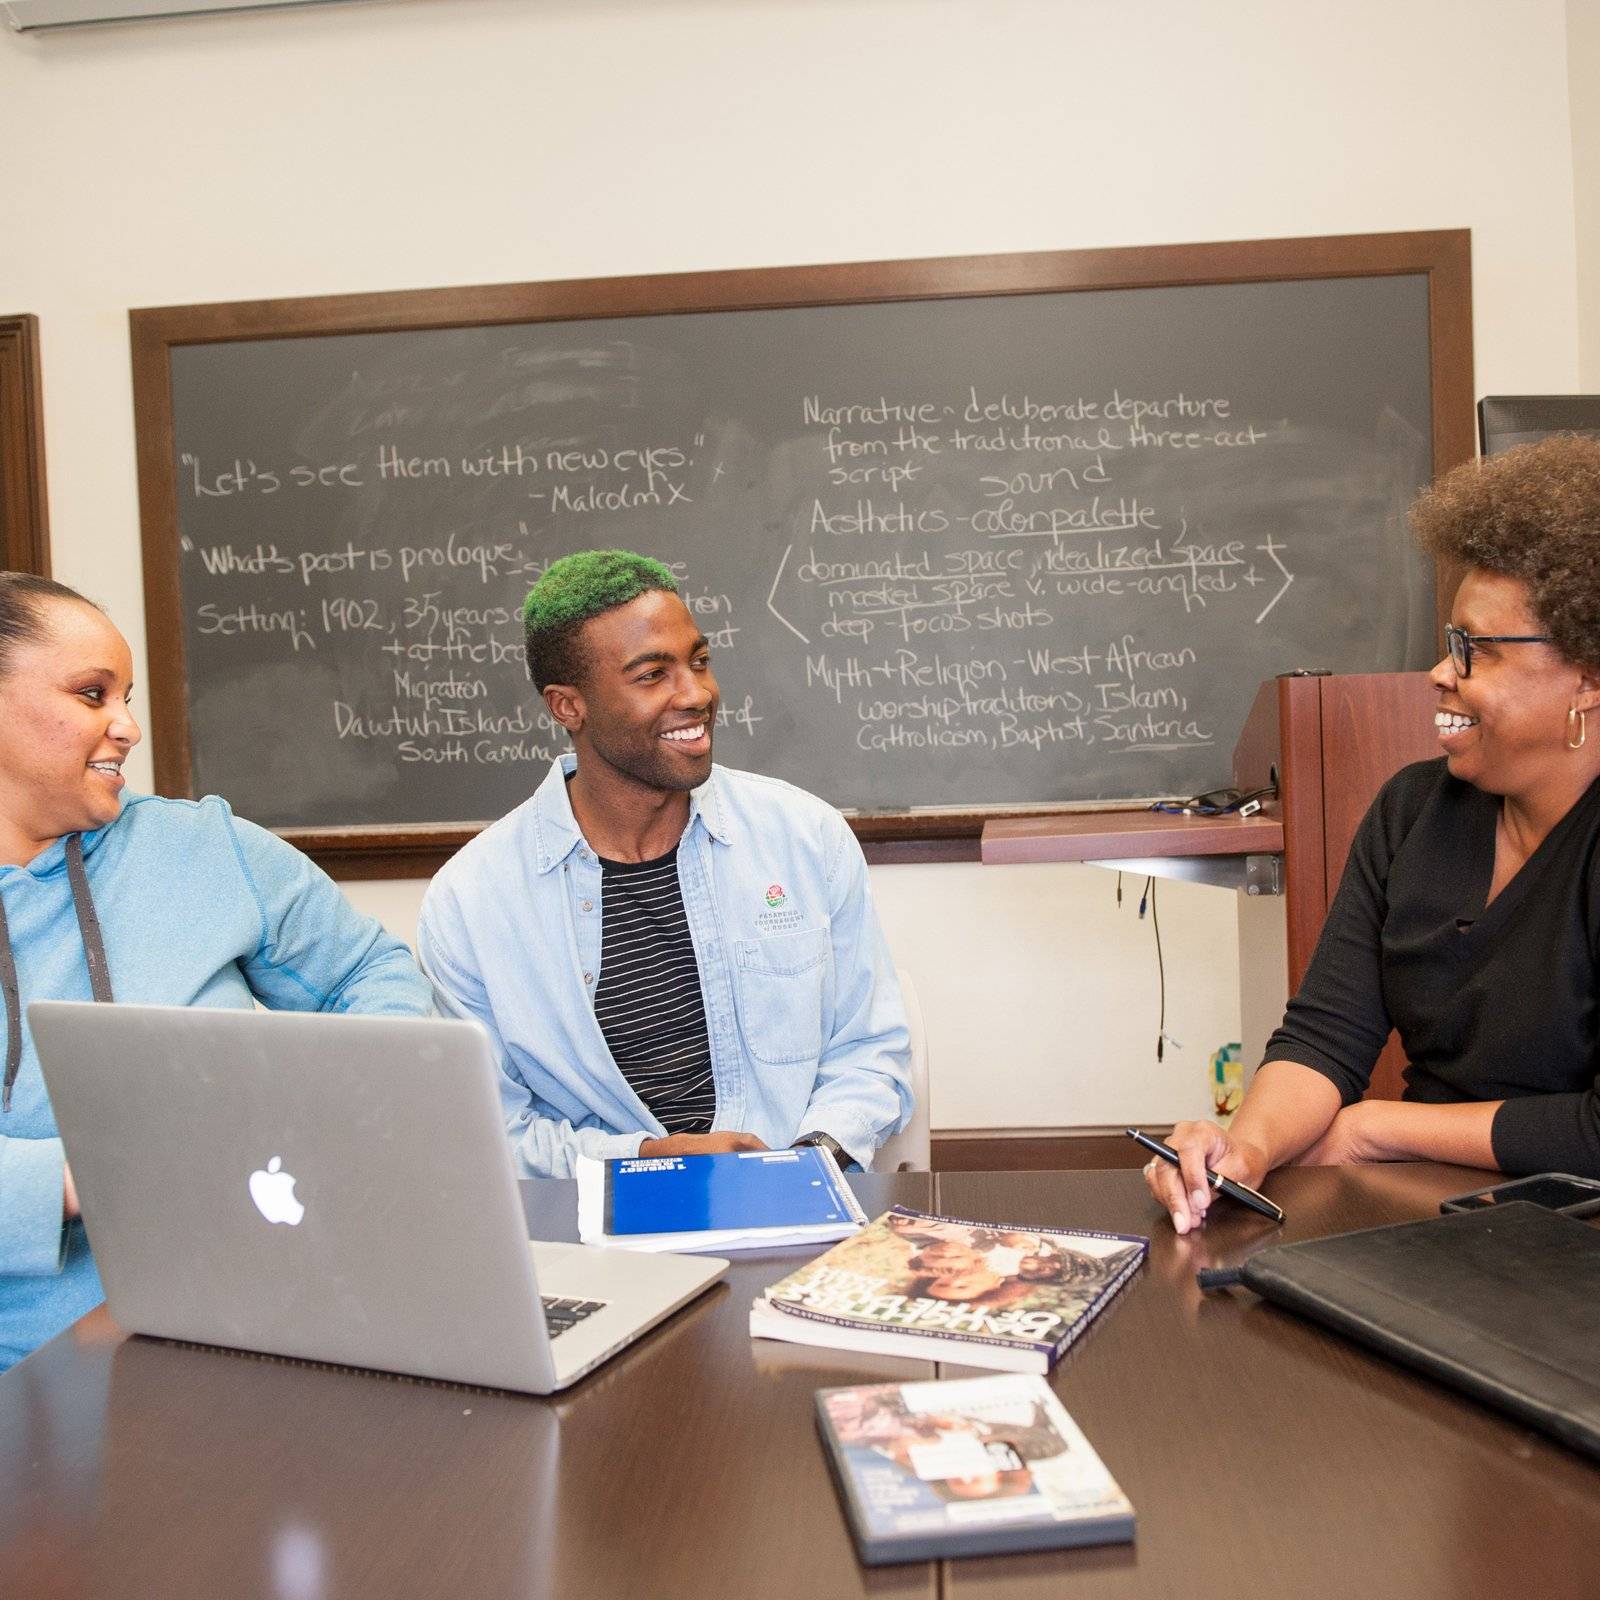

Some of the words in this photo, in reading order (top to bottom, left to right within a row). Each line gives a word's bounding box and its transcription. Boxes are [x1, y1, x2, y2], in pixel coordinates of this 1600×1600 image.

[803, 395, 942, 424] Narrative
[964, 385, 1099, 422] deliberate
[1104, 388, 1231, 430] departure
[823, 426, 888, 463] from
[892, 425, 940, 453] the
[949, 424, 1124, 451] traditional
[1129, 424, 1267, 448] three-act
[289, 464, 364, 487] see
[376, 444, 450, 478] them
[462, 445, 538, 477] with
[547, 449, 608, 471] new
[829, 460, 922, 492] script
[979, 454, 1112, 496] sound
[668, 483, 693, 505] X
[811, 498, 949, 534] Aesthetics
[971, 498, 1050, 533] color
[298, 542, 366, 586] past
[370, 548, 393, 570] is
[798, 547, 943, 583] dominated
[1038, 539, 1162, 571] idealized
[1169, 541, 1246, 592] space
[403, 591, 441, 635] 35
[442, 606, 511, 641] years
[829, 582, 922, 607] masked
[932, 580, 1016, 615] space
[977, 601, 1054, 630] shots
[442, 636, 486, 663] the
[806, 654, 872, 703] Myth
[896, 647, 1007, 697] Religion
[1028, 645, 1100, 675] West
[1105, 634, 1196, 680] African
[394, 666, 487, 711] Migration
[334, 700, 441, 739] Dawtuh
[438, 705, 533, 736] Island
[735, 695, 763, 736] of
[857, 695, 961, 725] worship
[1094, 713, 1213, 742] Santeria
[398, 740, 469, 763] South
[474, 740, 553, 764] Carolina
